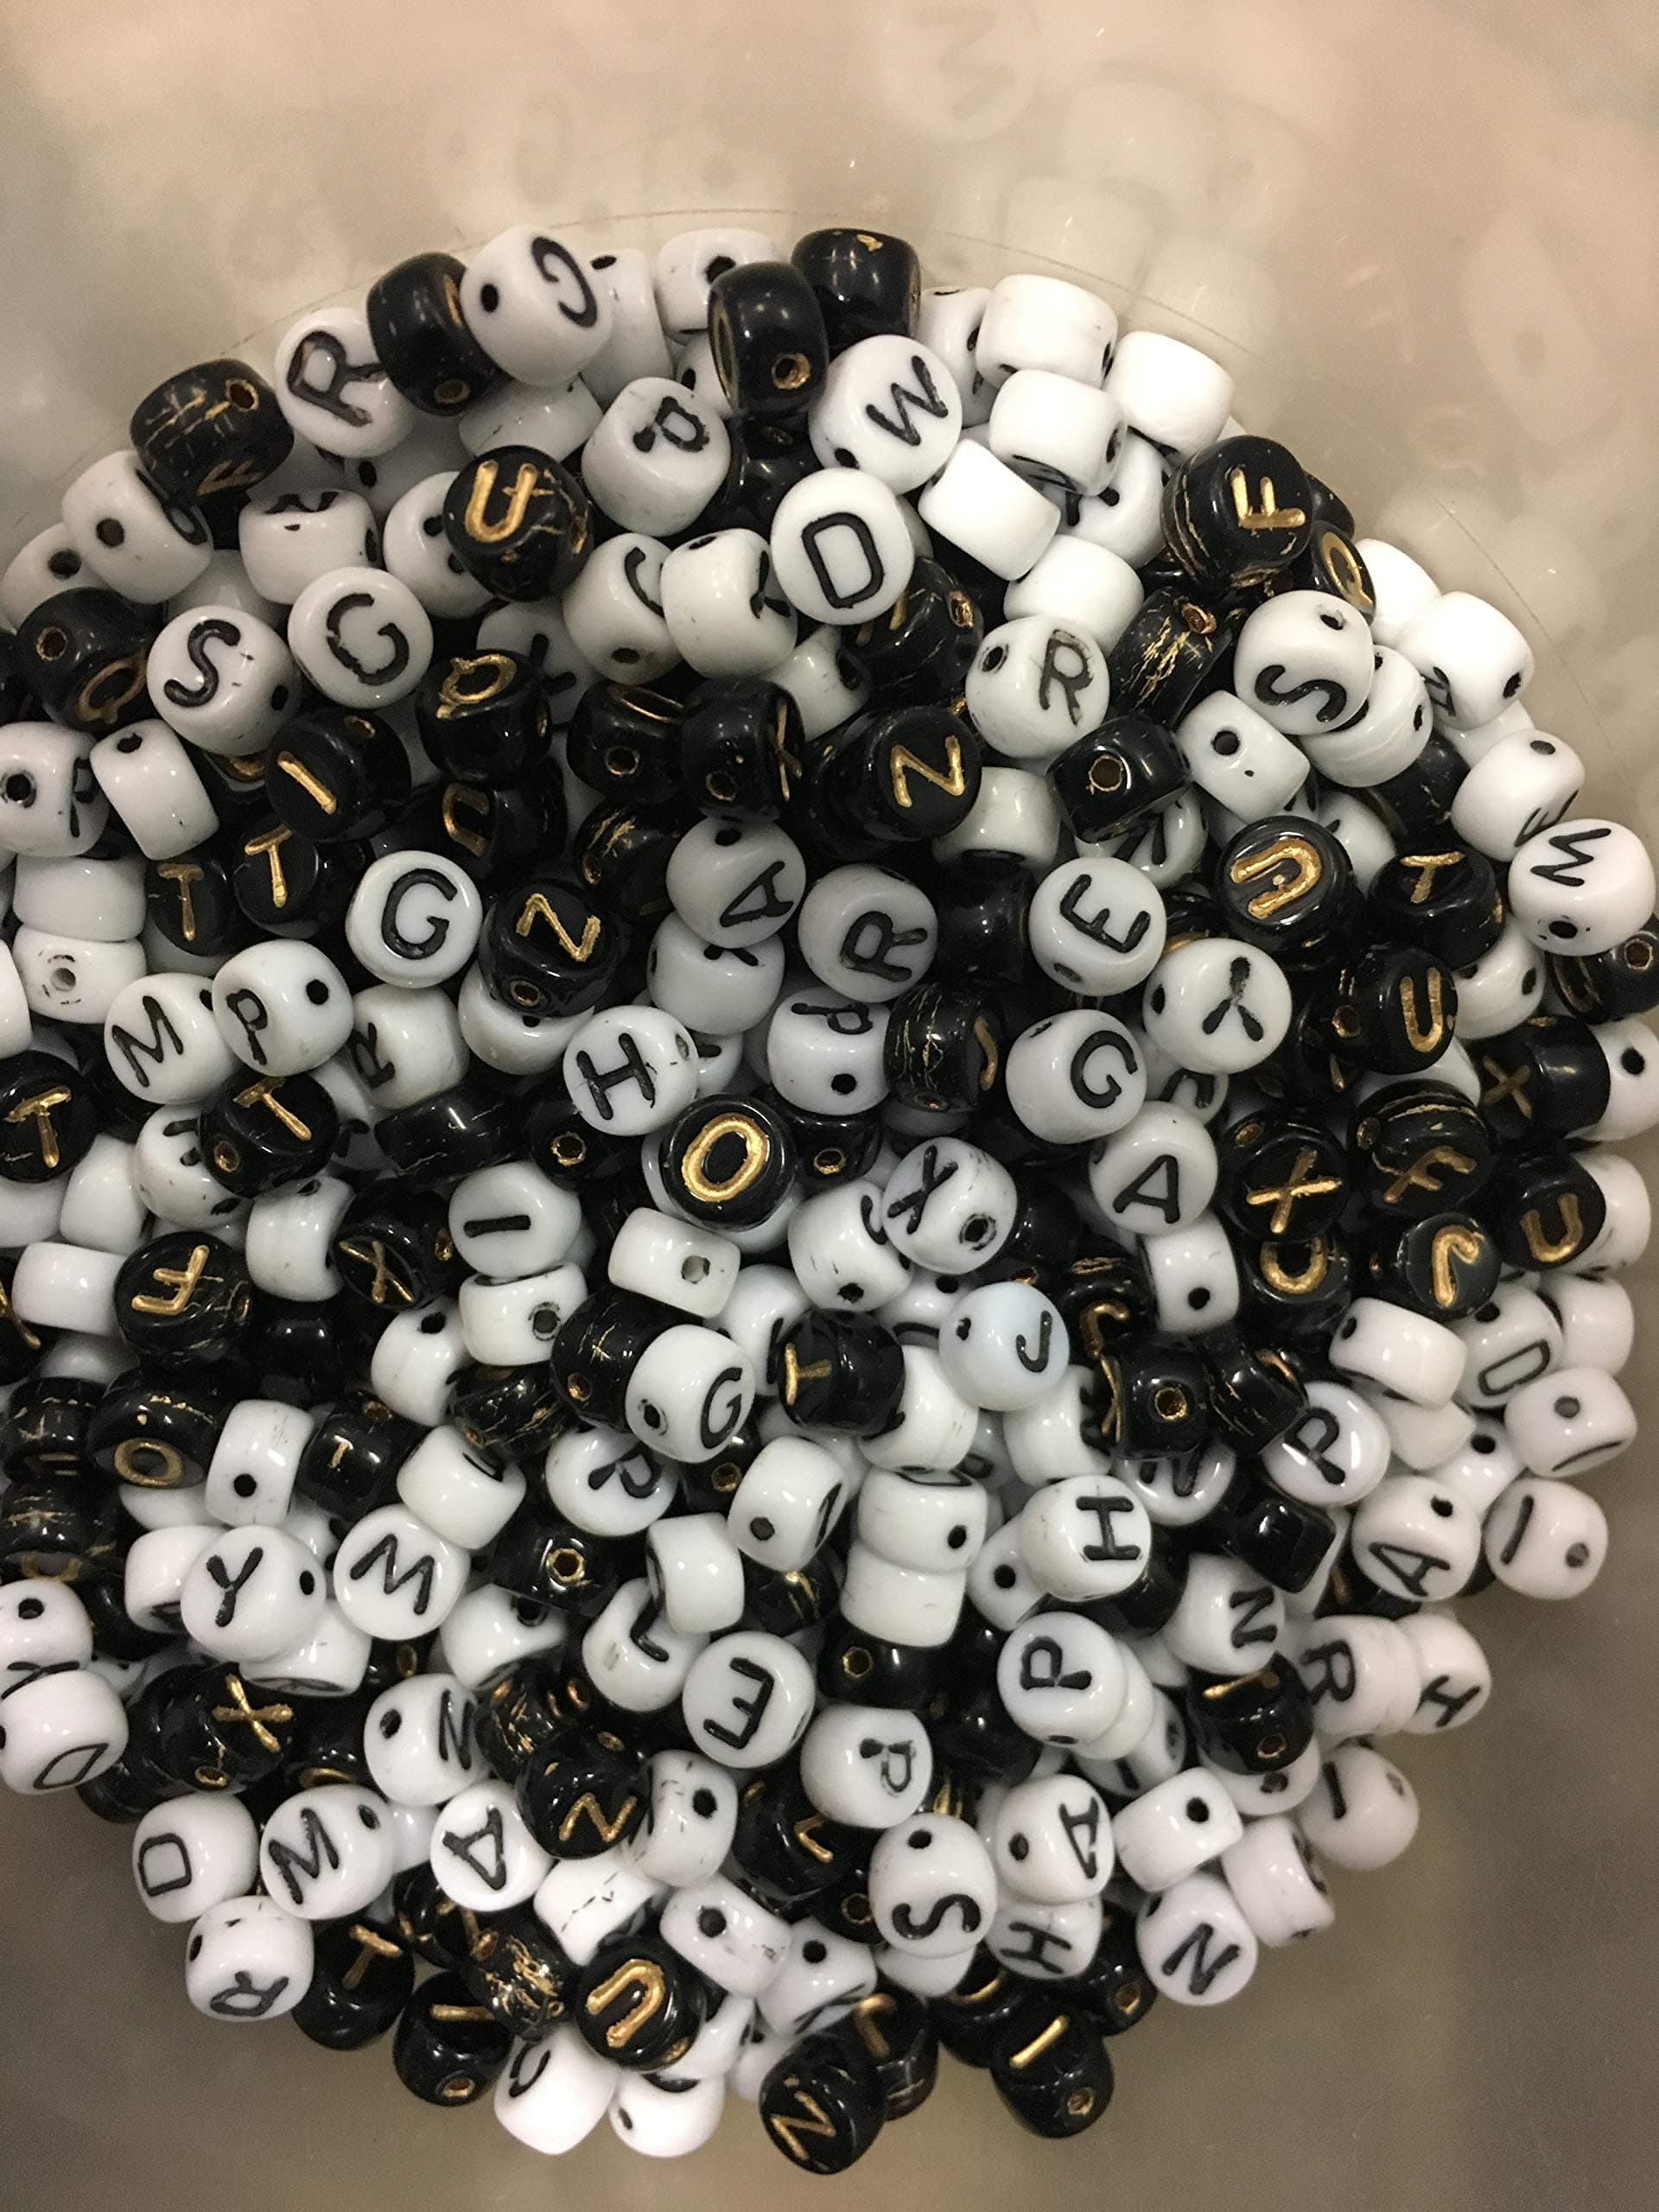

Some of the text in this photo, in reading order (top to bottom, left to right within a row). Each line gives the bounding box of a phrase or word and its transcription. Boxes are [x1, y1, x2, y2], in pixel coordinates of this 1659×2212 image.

[286, 330, 387, 428] R
[465, 460, 537, 543] U
[1230, 467, 1306, 529] F
[801, 512, 886, 609] D
[164, 619, 241, 708] S
[1039, 629, 1093, 727] R
[1254, 664, 1348, 723] S
[276, 751, 338, 815] I
[158, 864, 204, 941] T
[245, 824, 292, 908] T
[720, 861, 794, 928] A
[1230, 838, 1323, 919] U
[1400, 850, 1466, 904] T
[381, 868, 459, 960] G
[839, 911, 928, 982] R
[1059, 874, 1152, 954] E
[226, 988, 269, 1067] P
[1201, 956, 1265, 1042] Y
[1399, 967, 1444, 1053] U
[111, 995, 184, 1088] M
[575, 1033, 656, 1121] H
[1070, 1030, 1139, 1109] G
[5, 1086, 72, 1169] T
[232, 1076, 312, 1141] T
[680, 1112, 771, 1204] O
[887, 1145, 960, 1235] X
[1111, 1154, 1181, 1224] A
[1246, 1146, 1342, 1235] X
[463, 1213, 531, 1239] I
[1519, 1190, 1584, 1262] U
[131, 1244, 209, 1316] F
[340, 1239, 415, 1304] X
[784, 1342, 832, 1407] T
[1015, 1310, 1053, 1373] J
[700, 1366, 743, 1450] G
[1282, 1407, 1346, 1486] P
[113, 1437, 183, 1490] O
[1368, 1541, 1452, 1598] A
[1500, 1495, 1535, 1566] I
[205, 1546, 264, 1628] Y
[1020, 1636, 1092, 1691] P
[211, 1673, 294, 1752] X
[438, 1688, 474, 1770] N
[703, 1656, 776, 1751] E
[137, 1832, 193, 1897] D
[268, 1807, 340, 1905] M
[442, 1805, 507, 1891] A
[1058, 1796, 1100, 1880] A
[891, 1892, 982, 1941] S
[1000, 1921, 1072, 1975] H
[1161, 1922, 1242, 1996] N
[585, 1958, 664, 2048] U
[1009, 2015, 1070, 2070] I
[771, 2091, 836, 2161] N
